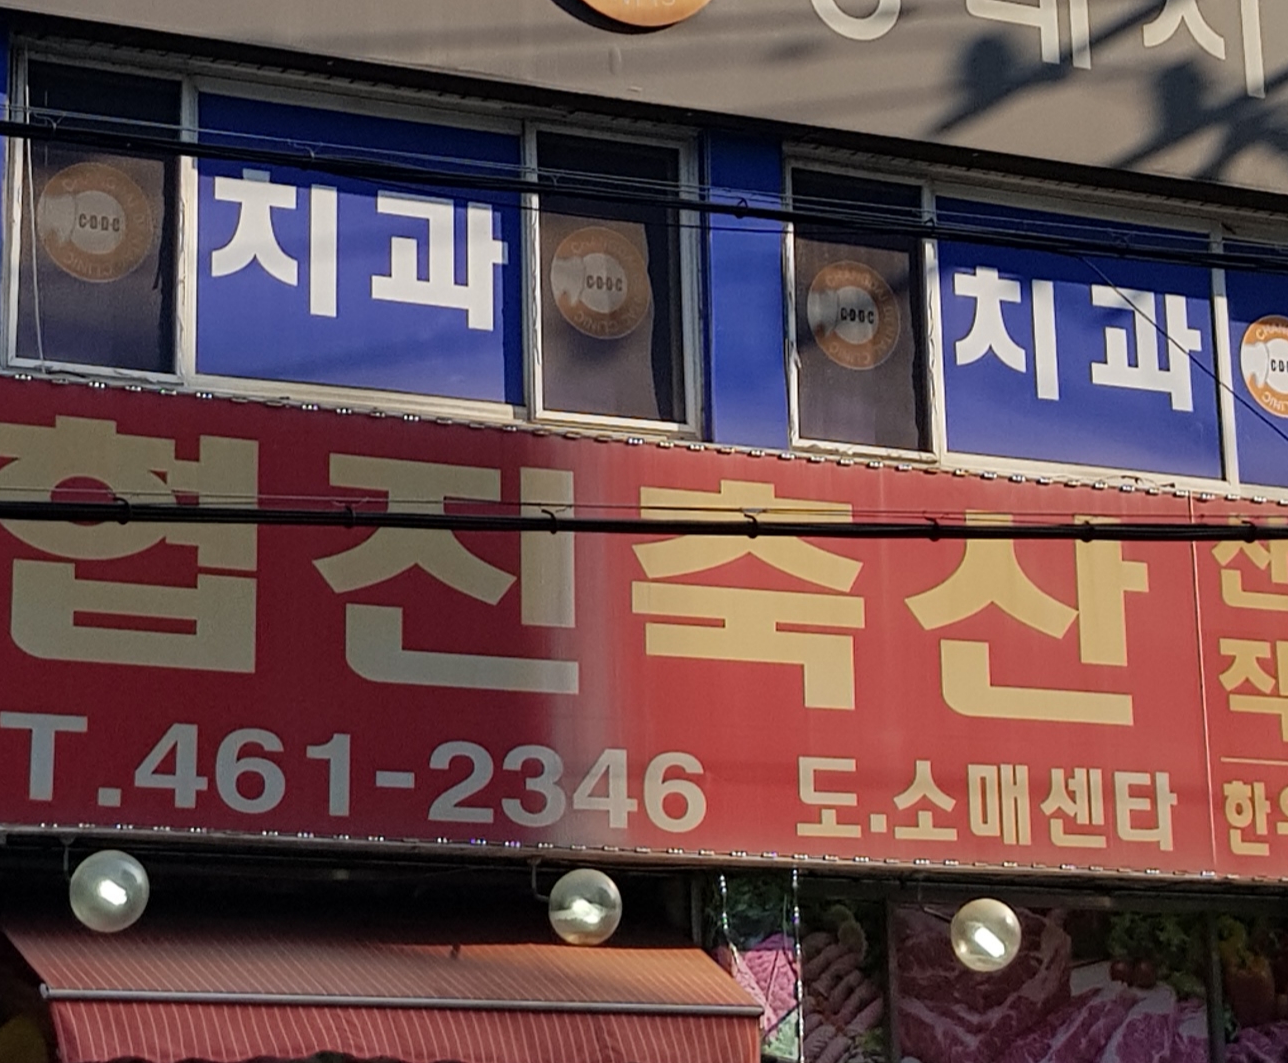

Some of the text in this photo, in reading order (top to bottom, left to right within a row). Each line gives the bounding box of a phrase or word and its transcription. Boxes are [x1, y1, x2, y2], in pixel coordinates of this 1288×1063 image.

[210, 169, 508, 331] 치과
[953, 266, 1202, 412] 치과
[0, 711, 707, 833] T.461-2346
[797, 756, 1177, 851] 도.소매센타
